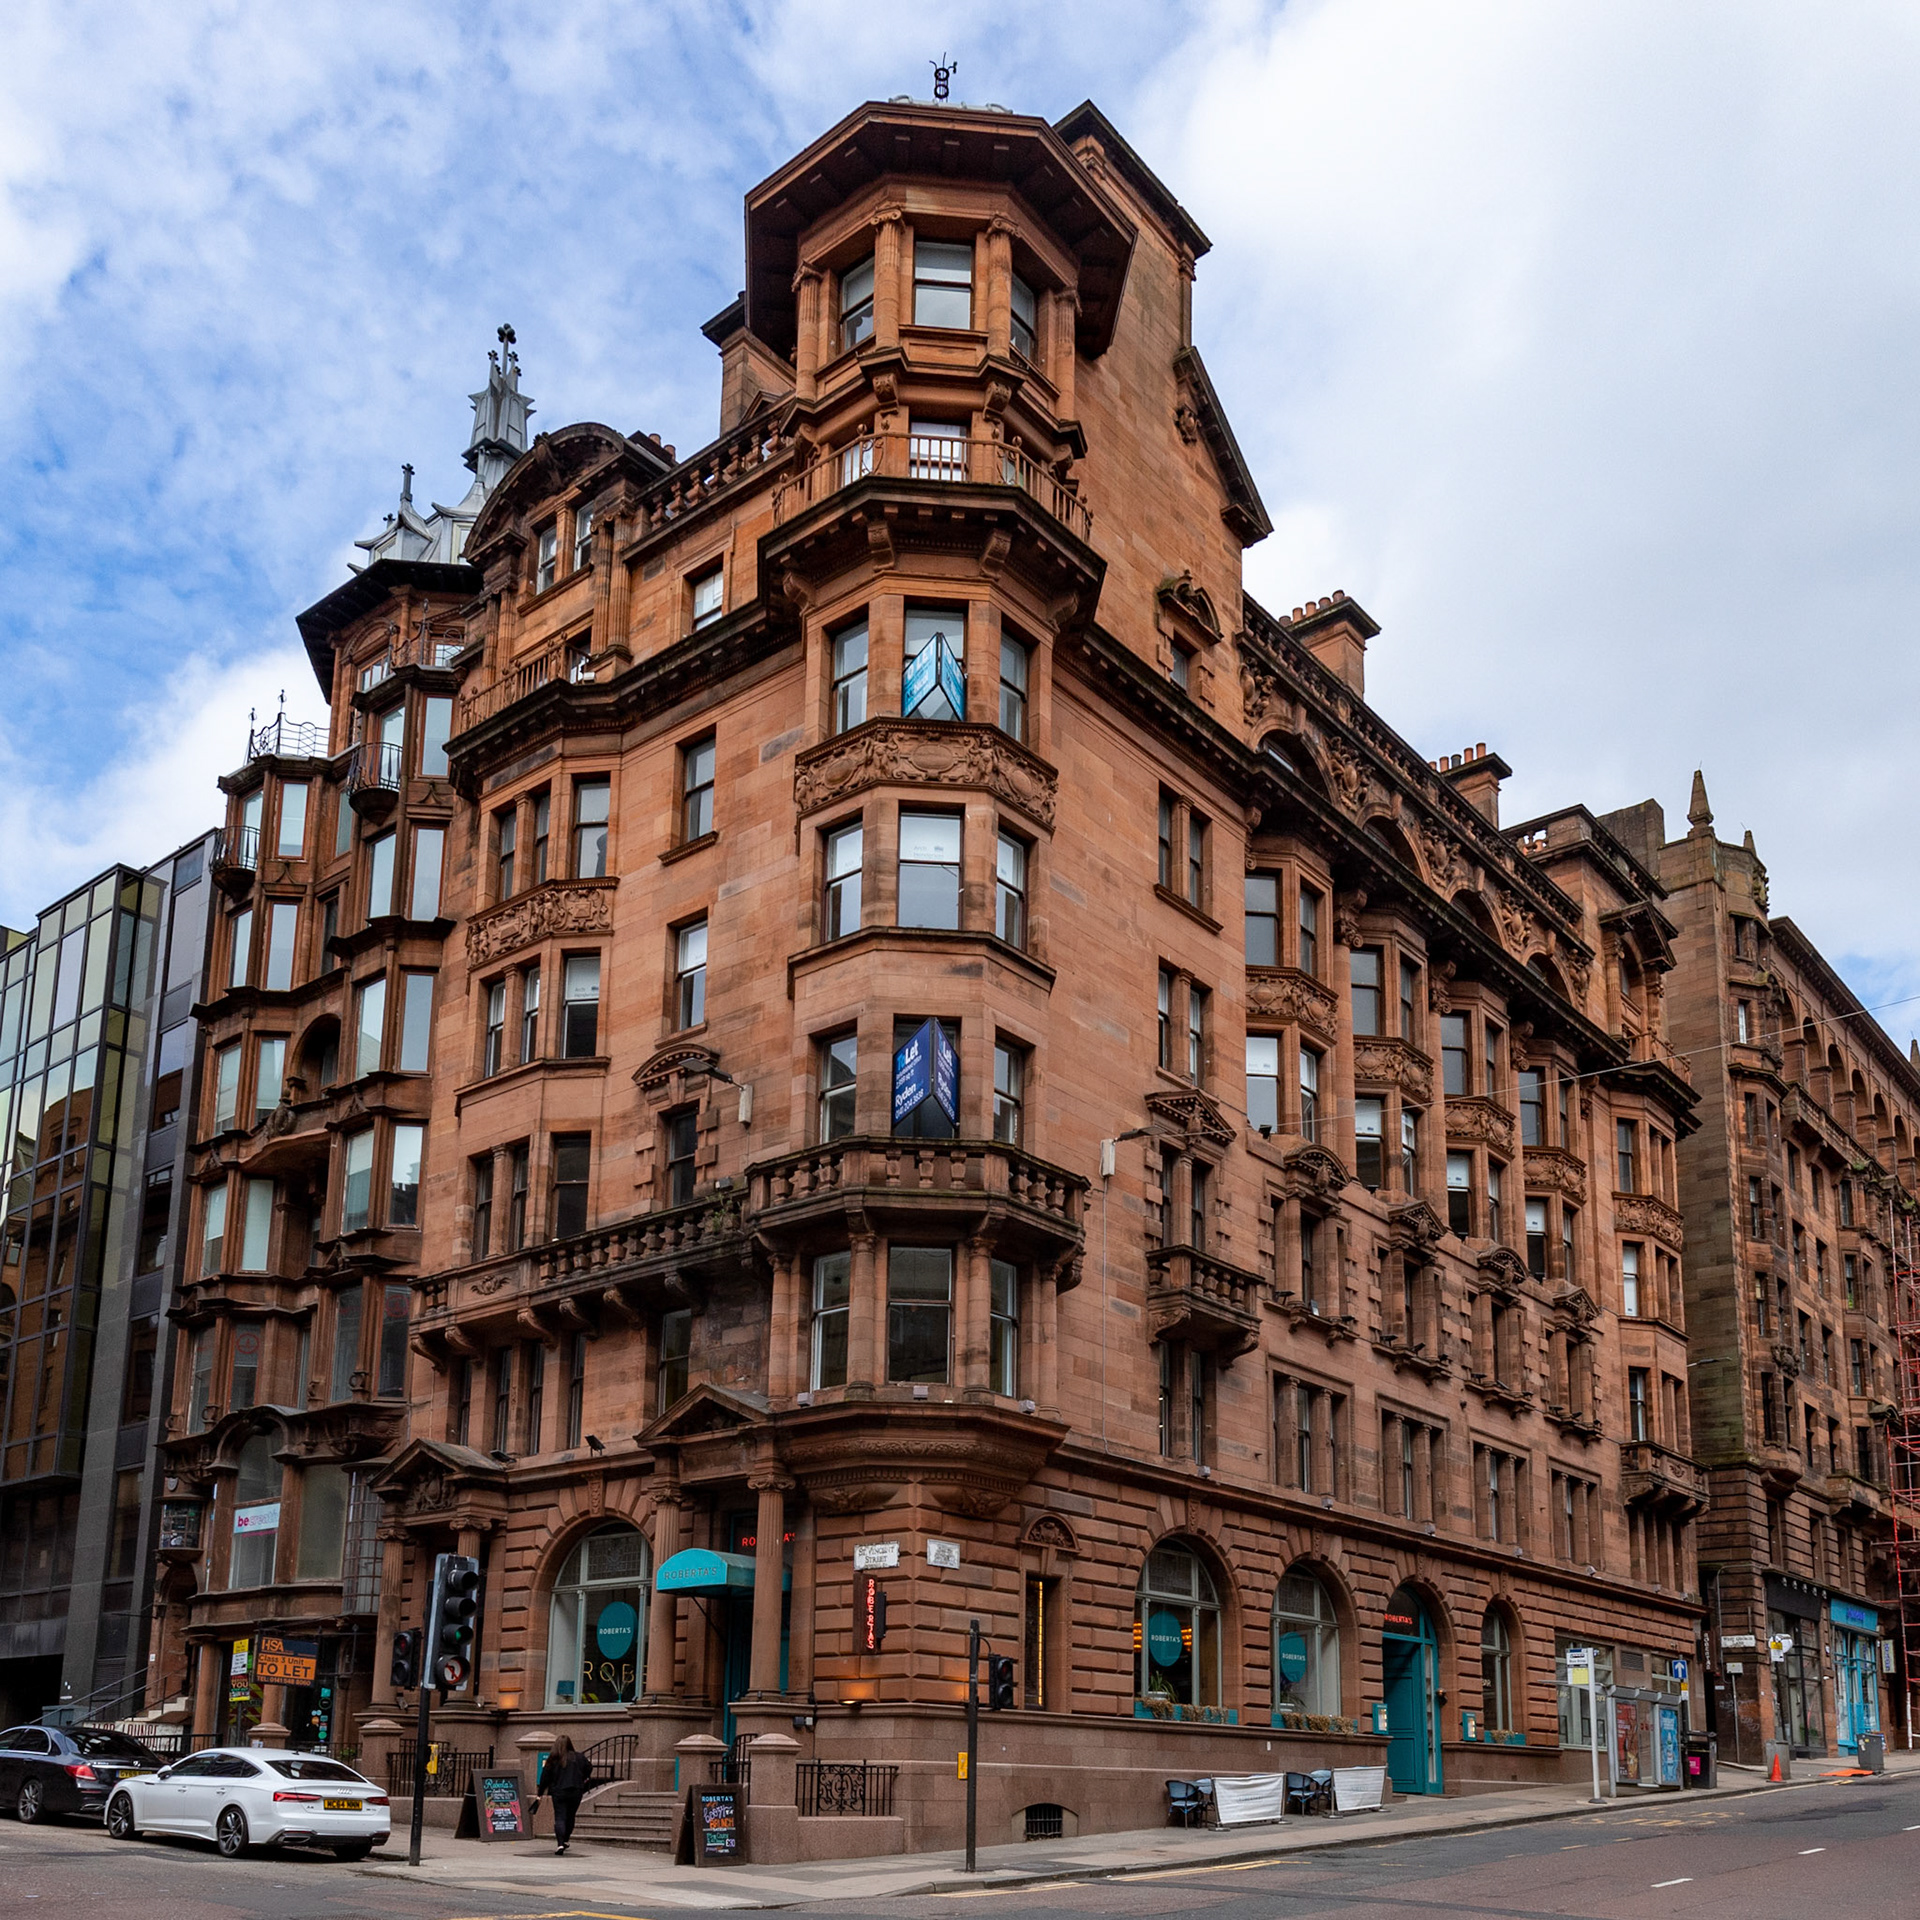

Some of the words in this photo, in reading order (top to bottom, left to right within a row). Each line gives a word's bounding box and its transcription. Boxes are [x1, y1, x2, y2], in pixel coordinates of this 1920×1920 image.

[905, 1040, 919, 1065] Let
[895, 1083, 916, 1107] Ryden
[865, 1556, 888, 1564] STREET
[664, 1567, 718, 1580] ROBERTA'S
[599, 1627, 631, 1635] ROBERTA'S
[1151, 1634, 1181, 1643] ROBERTA'S
[262, 1638, 284, 1652] HSA
[259, 1654, 279, 1663] Class
[288, 1658, 304, 1666] Unit
[1282, 1652, 1306, 1661] ROBERTA'S
[258, 1662, 278, 1675] TO
[283, 1664, 311, 1678] LET
